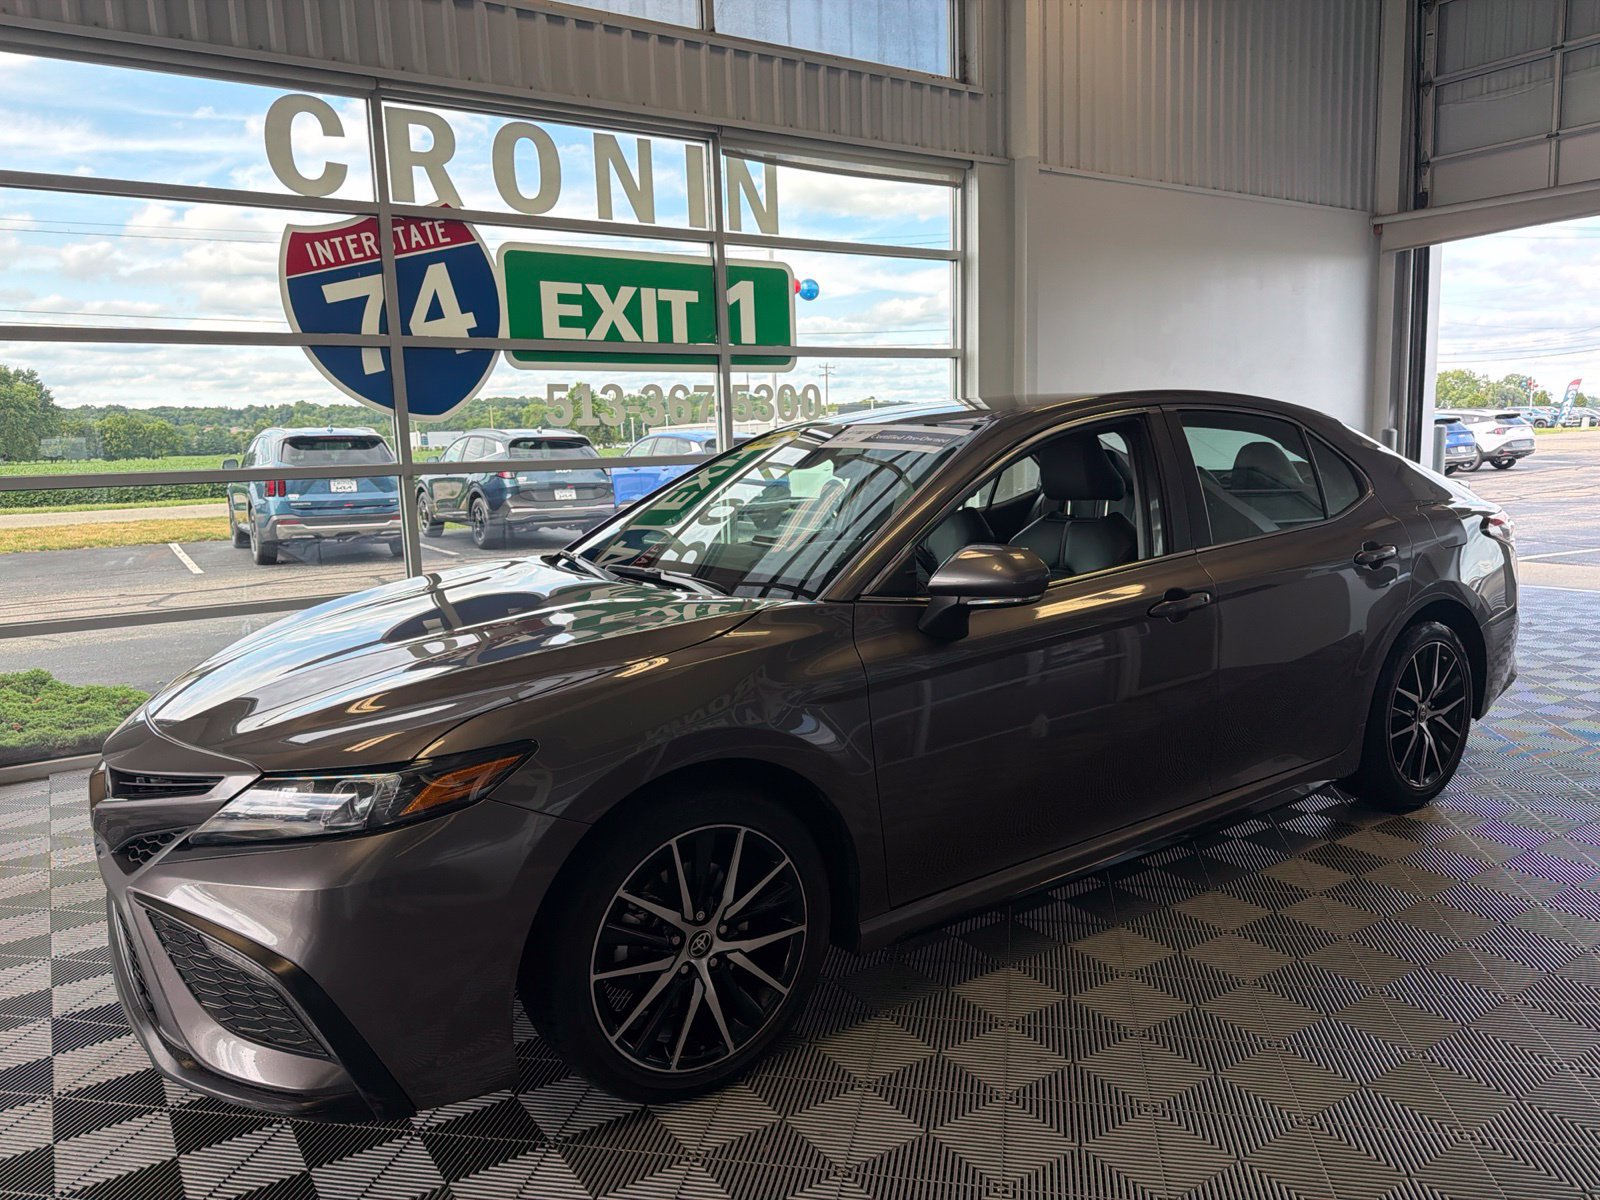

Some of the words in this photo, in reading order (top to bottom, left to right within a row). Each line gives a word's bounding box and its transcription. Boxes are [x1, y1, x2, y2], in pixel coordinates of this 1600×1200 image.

[264, 93, 780, 235] CRONIN
[305, 219, 451, 267] INTERTATE
[321, 262, 479, 376] 74
[539, 280, 699, 344] EXIT
[727, 279, 757, 345] 1
[546, 383, 822, 426] 513-3675300
